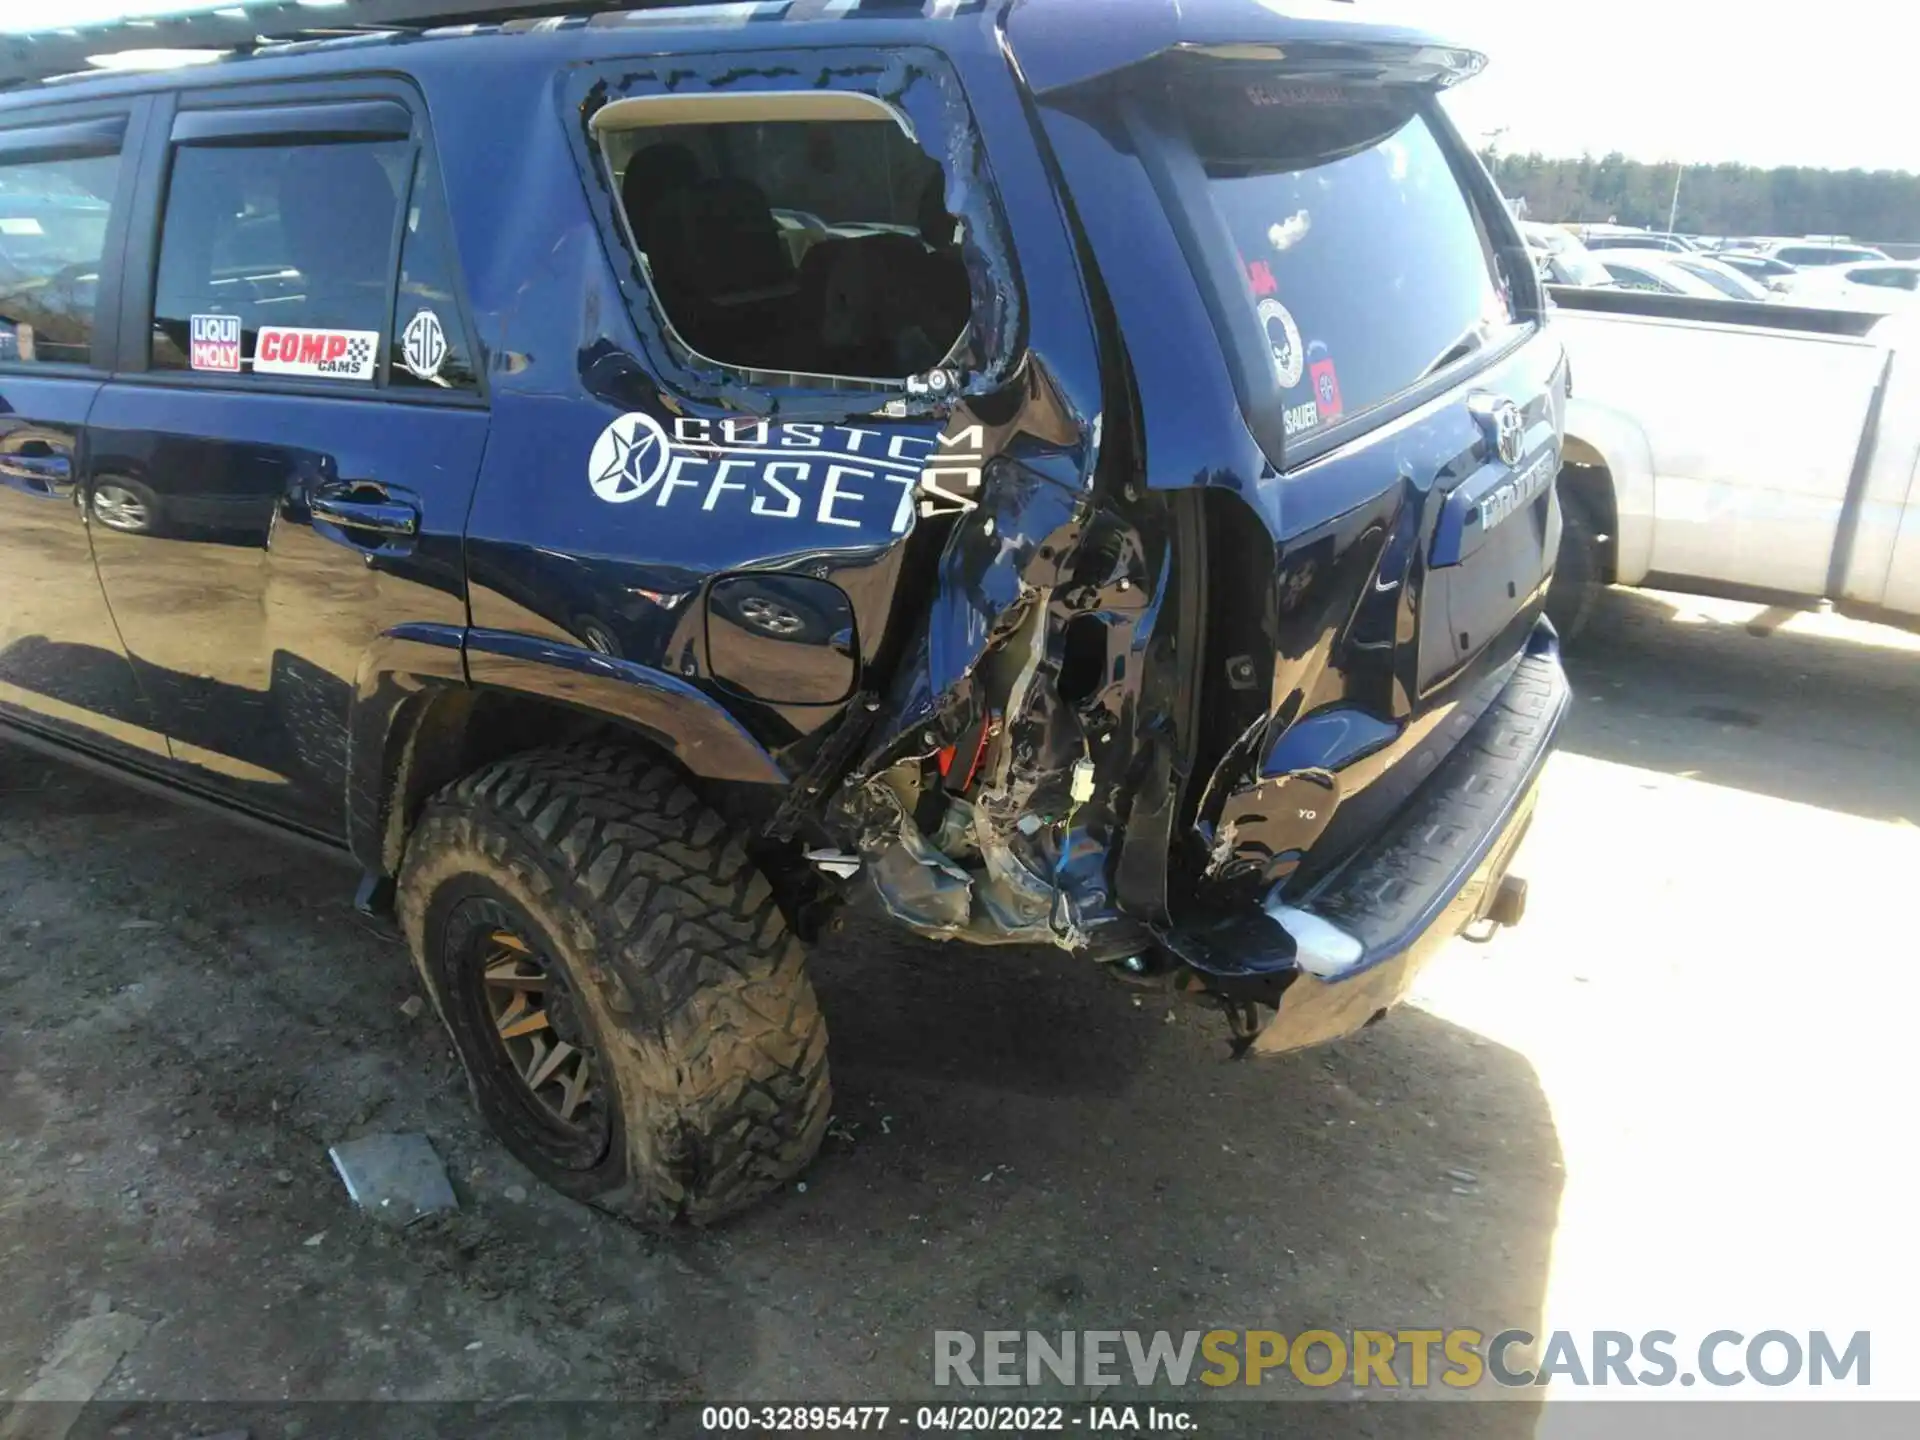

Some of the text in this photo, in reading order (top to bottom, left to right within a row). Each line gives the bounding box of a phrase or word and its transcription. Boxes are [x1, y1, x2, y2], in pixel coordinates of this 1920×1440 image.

[194, 319, 237, 342] LIQUI
[405, 317, 443, 368] SIG
[194, 342, 239, 368] MOLY
[262, 331, 347, 363] COMP
[317, 359, 361, 374] CAMS
